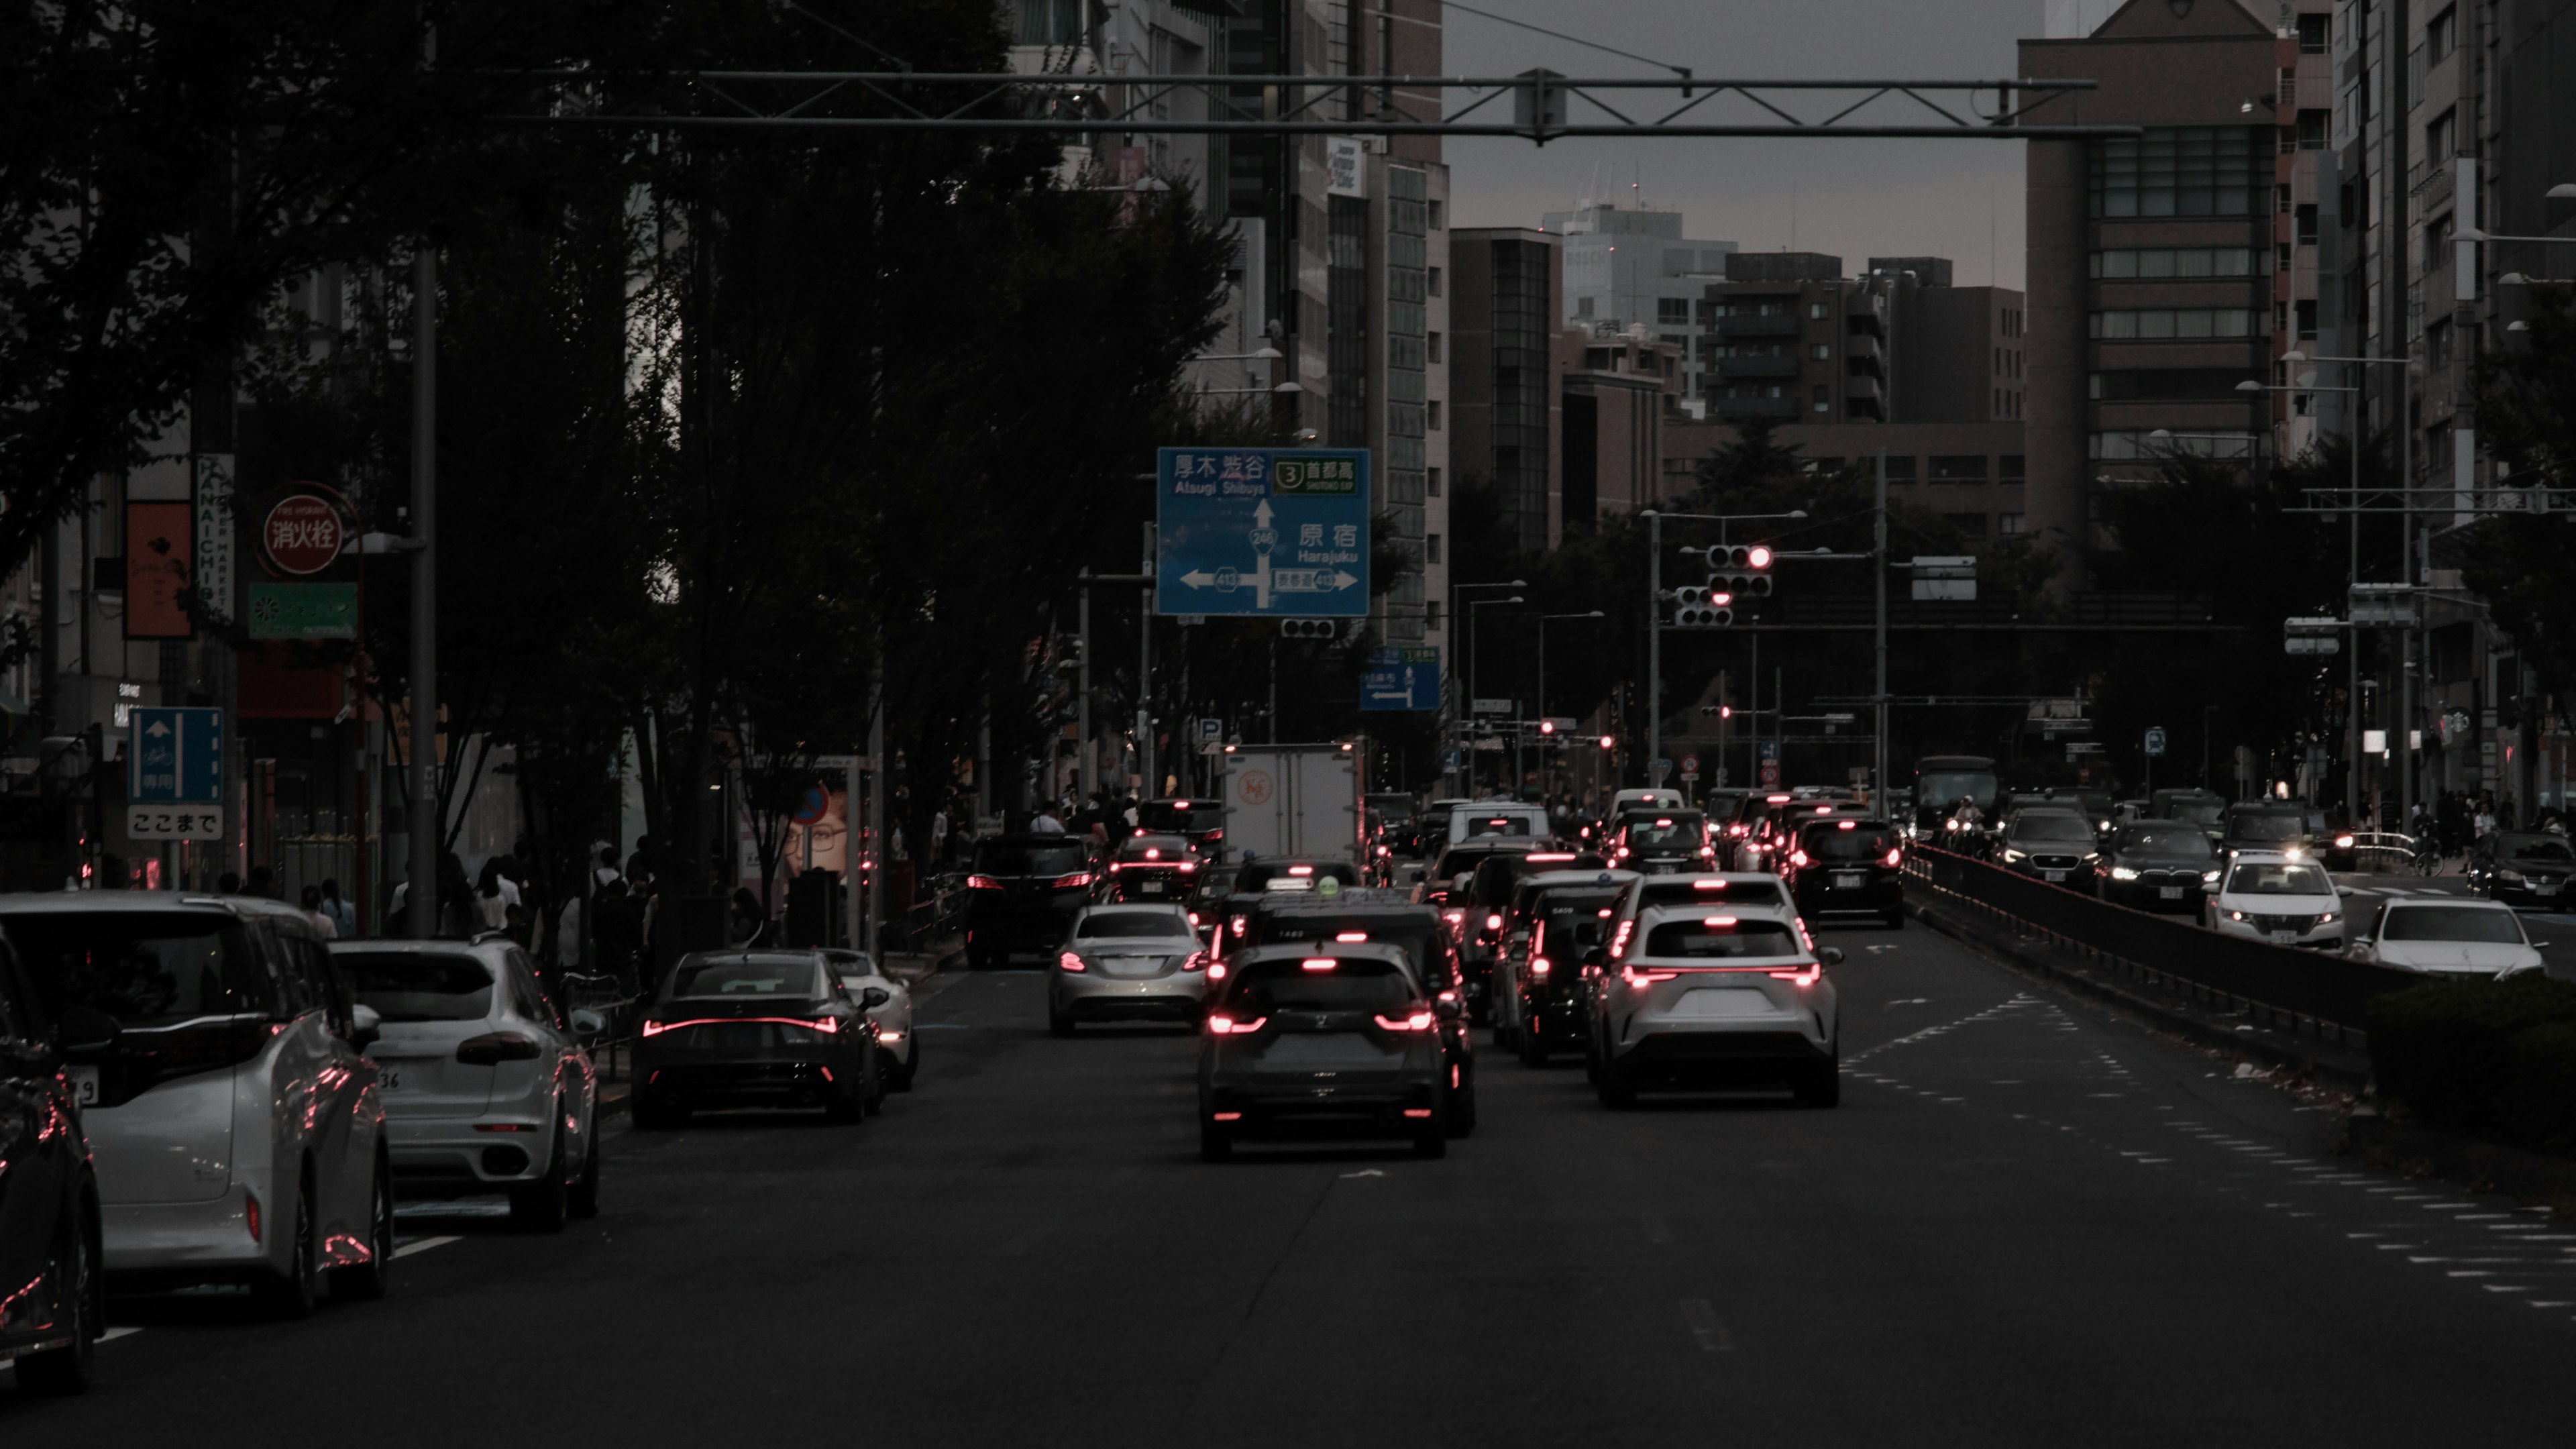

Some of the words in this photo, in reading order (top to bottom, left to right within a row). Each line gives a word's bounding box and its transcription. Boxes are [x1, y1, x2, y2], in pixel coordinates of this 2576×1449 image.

[1175, 454, 1216, 479] 厚木
[1221, 454, 1265, 480] 渋谷
[1285, 466, 1297, 483] 3
[1307, 461, 1354, 480] 首都高
[1175, 481, 1216, 496] Atsugi
[1222, 480, 1265, 496] Shibuya
[272, 519, 335, 549] 消火栓
[1299, 523, 1358, 547] 原宿
[1297, 549, 1358, 565] Harajuku
[1216, 572, 1236, 586] 413
[1202, 720, 1220, 739] P
[142, 773, 174, 790] 専用
[133, 813, 217, 833] ここまで
